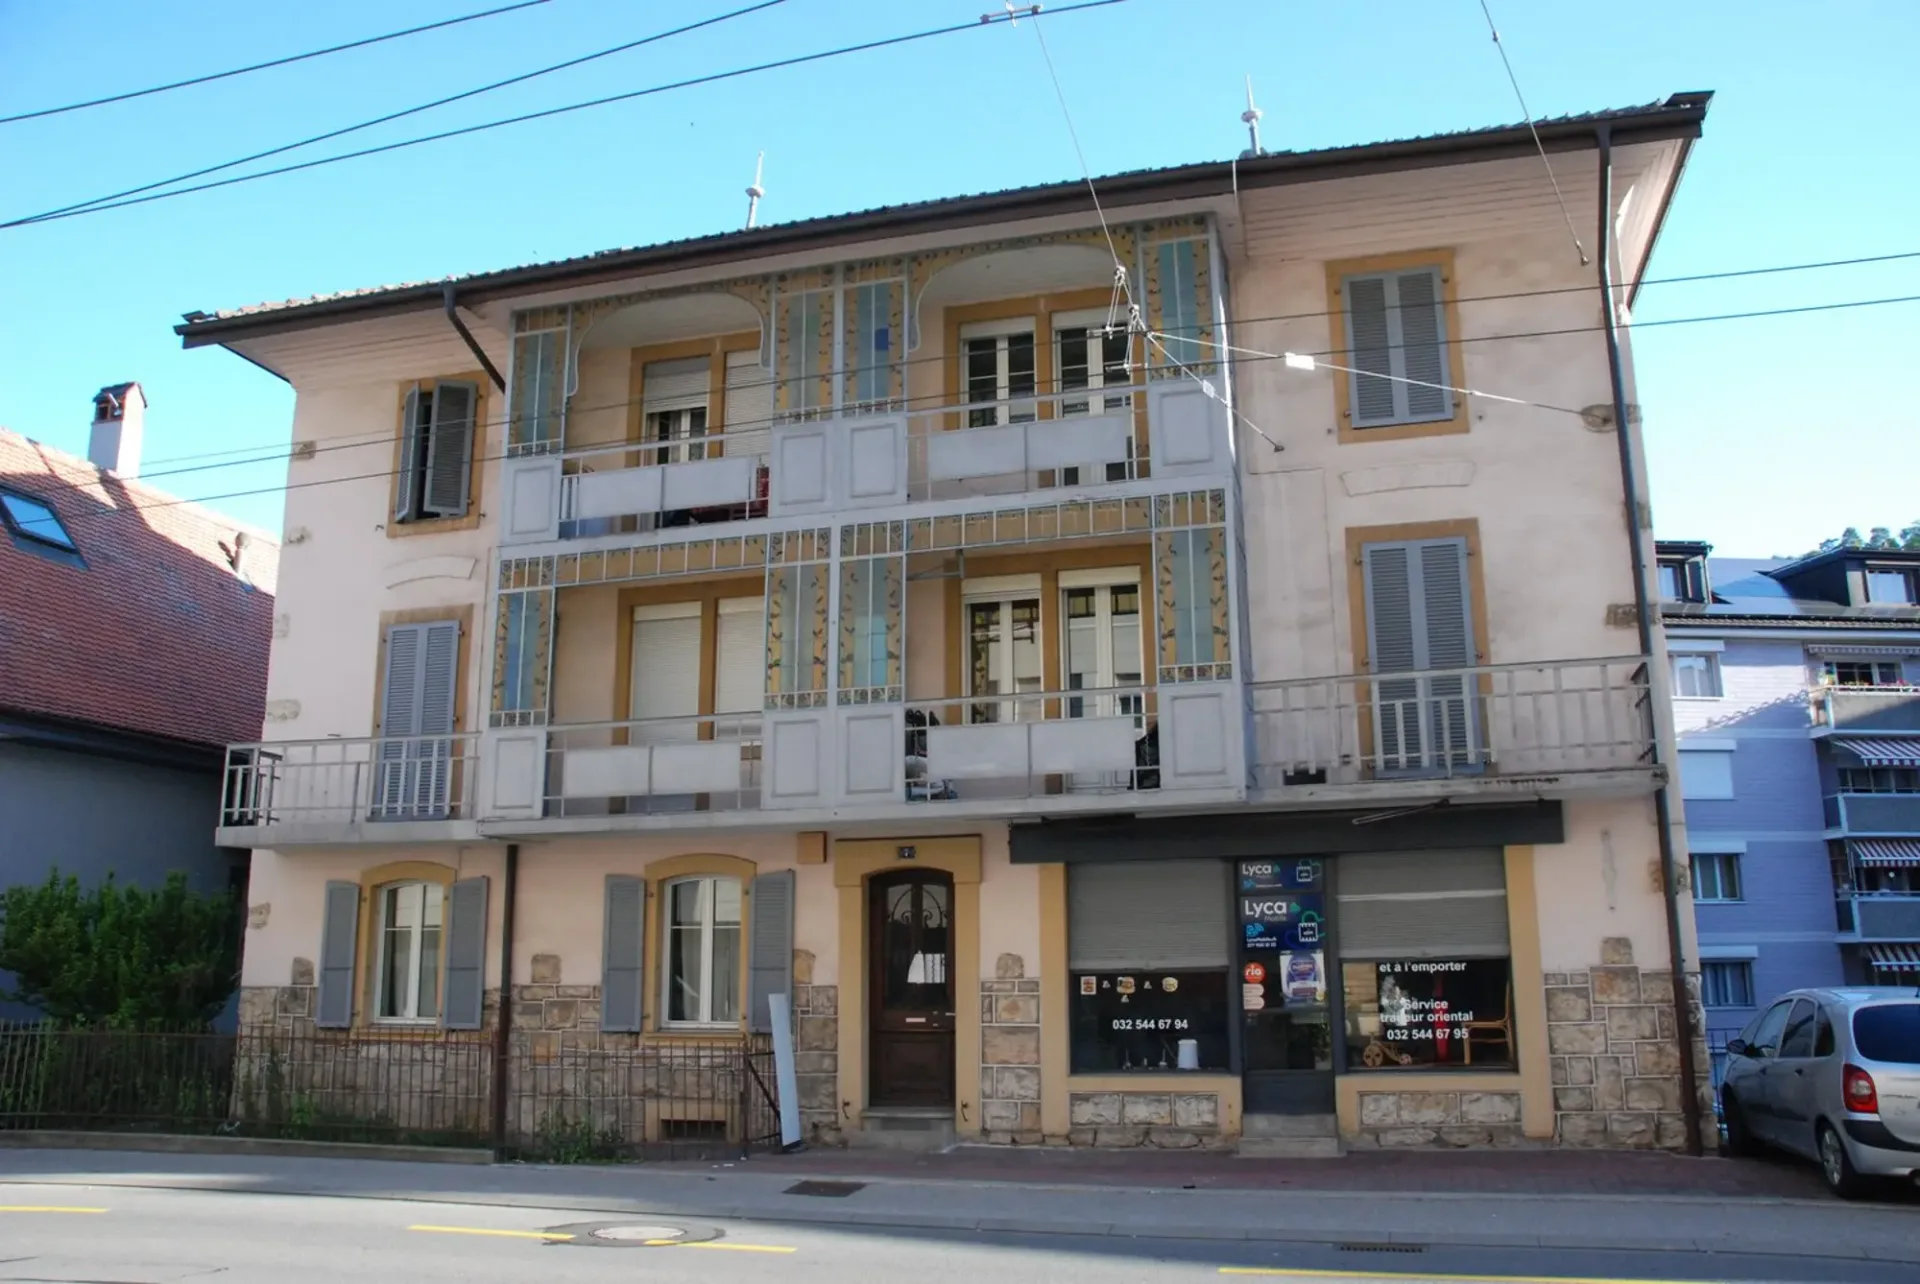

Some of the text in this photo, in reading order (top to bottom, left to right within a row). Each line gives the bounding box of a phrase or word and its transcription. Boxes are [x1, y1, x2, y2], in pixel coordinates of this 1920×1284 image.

[1242, 864, 1272, 876] Lyca
[1245, 900, 1287, 918] Lyca
[1379, 963, 1391, 972] et
[1404, 962, 1467, 974] l'emporter
[1404, 999, 1448, 1010] Service
[1427, 1011, 1473, 1022] oriental
[1112, 1019, 1188, 1030] 032 544 67 94
[1386, 1028, 1469, 1040] 032 544 67 95
